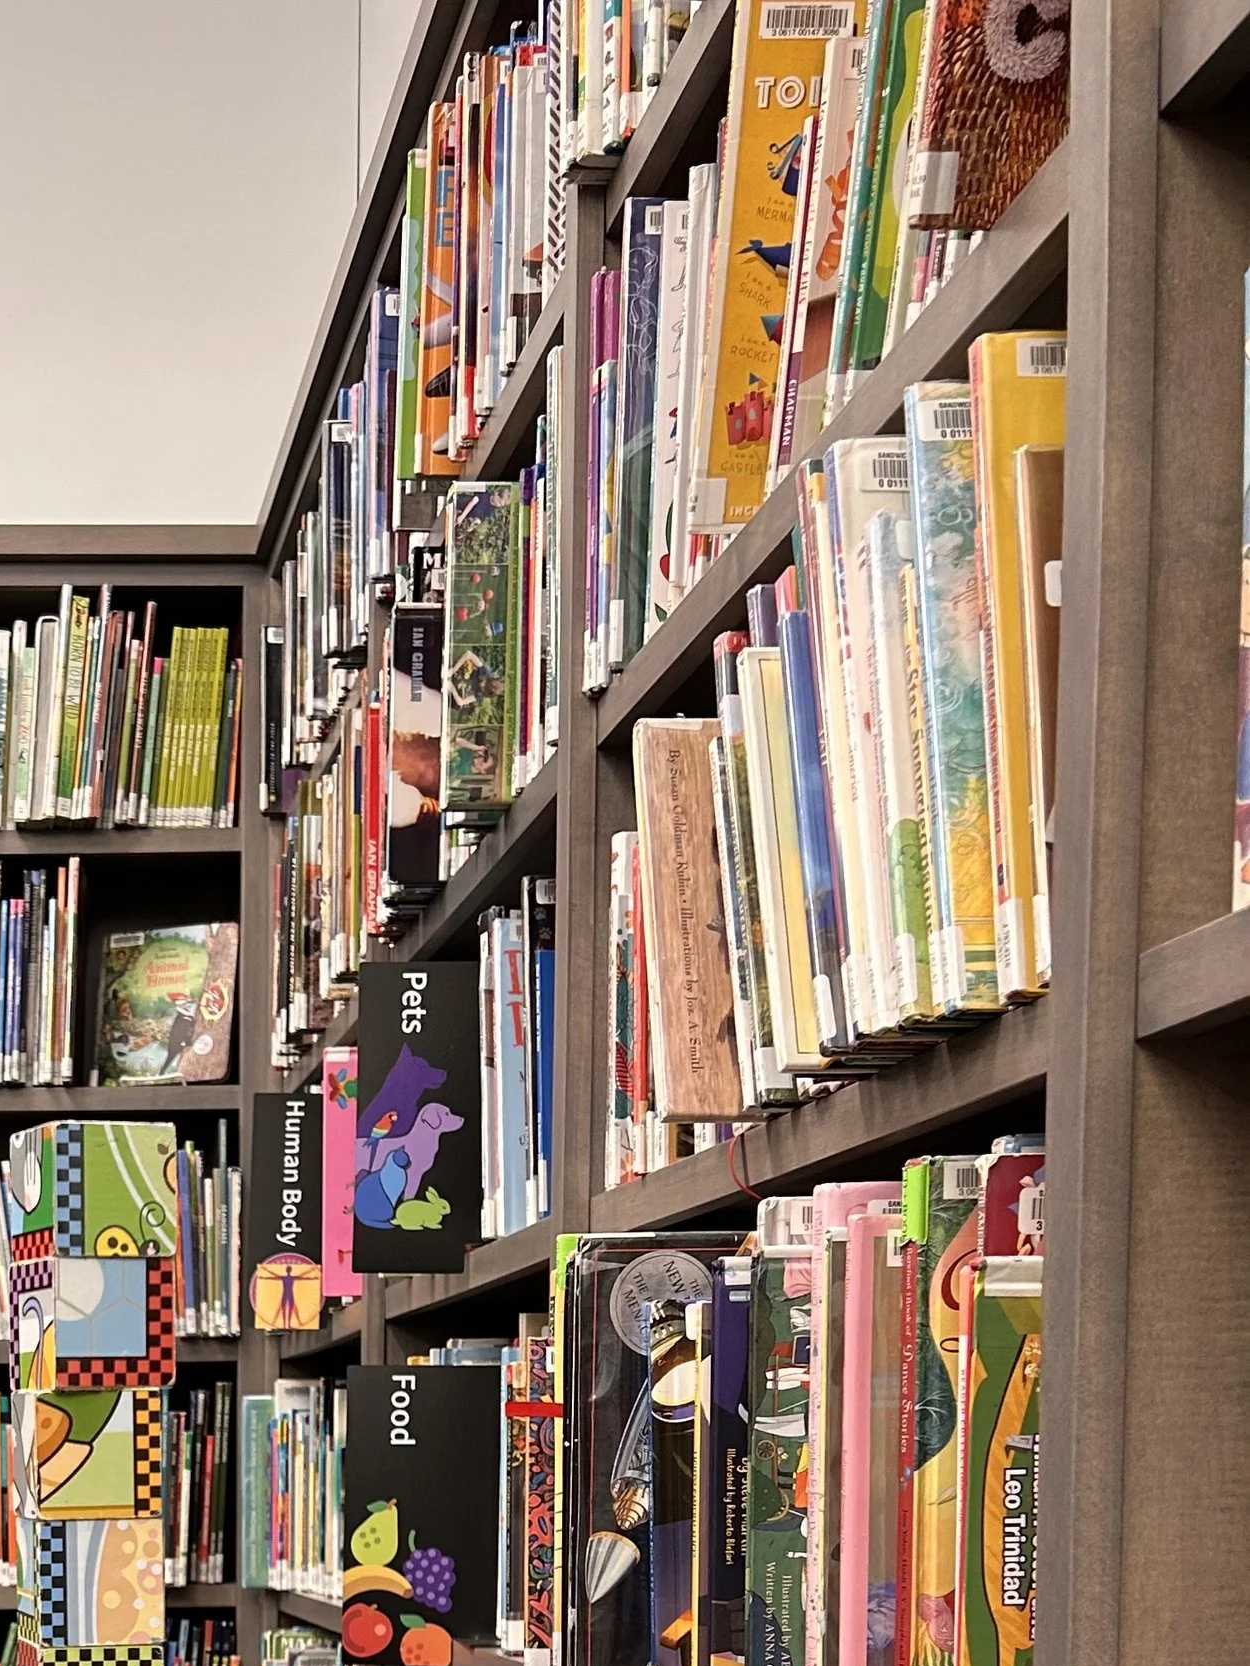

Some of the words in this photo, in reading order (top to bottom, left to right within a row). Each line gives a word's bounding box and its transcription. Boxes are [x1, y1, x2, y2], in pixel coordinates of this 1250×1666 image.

[738, 282, 772, 309] SHARK
[730, 345, 776, 364] ROCKET
[781, 378, 798, 448] CHAPMAN
[71, 634, 85, 665] BORN
[410, 626, 425, 648] IAN
[68, 677, 83, 693] BE
[409, 651, 426, 703] GRAHAM
[904, 666, 921, 718] Star
[66, 693, 81, 720] WILD
[667, 748, 680, 768] By
[669, 767, 682, 802] Susan
[671, 804, 685, 859] Goldman
[367, 839, 378, 864] IAN
[676, 859, 688, 900] Rubin
[366, 866, 379, 933] GRAHAM
[679, 906, 694, 977] Illustrations
[143, 957, 191, 974] Animal
[145, 974, 188, 987] Homes
[399, 970, 428, 1035] Pets
[684, 978, 694, 996] by
[689, 1035, 702, 1075] Smith
[282, 1099, 305, 1183] Human
[275, 1186, 303, 1248] Body
[633, 1271, 648, 1295] THE
[662, 1259, 687, 1295] NEW
[901, 1344, 915, 1396] Dance
[389, 1373, 417, 1447] Food
[900, 1398, 914, 1454] Stories
[726, 1447, 736, 1491] Illustrated
[723, 1491, 733, 1506] by
[1003, 1467, 1027, 1510] Leo
[726, 1506, 735, 1540] Roberto
[726, 1540, 735, 1566] Blefari
[1002, 1512, 1027, 1607] Trinidad
[765, 1561, 777, 1605] Written
[781, 1573, 792, 1627] Illustrated
[762, 1605, 774, 1622] by
[764, 1622, 775, 1660] ANNA
[779, 1628, 790, 1645] by
